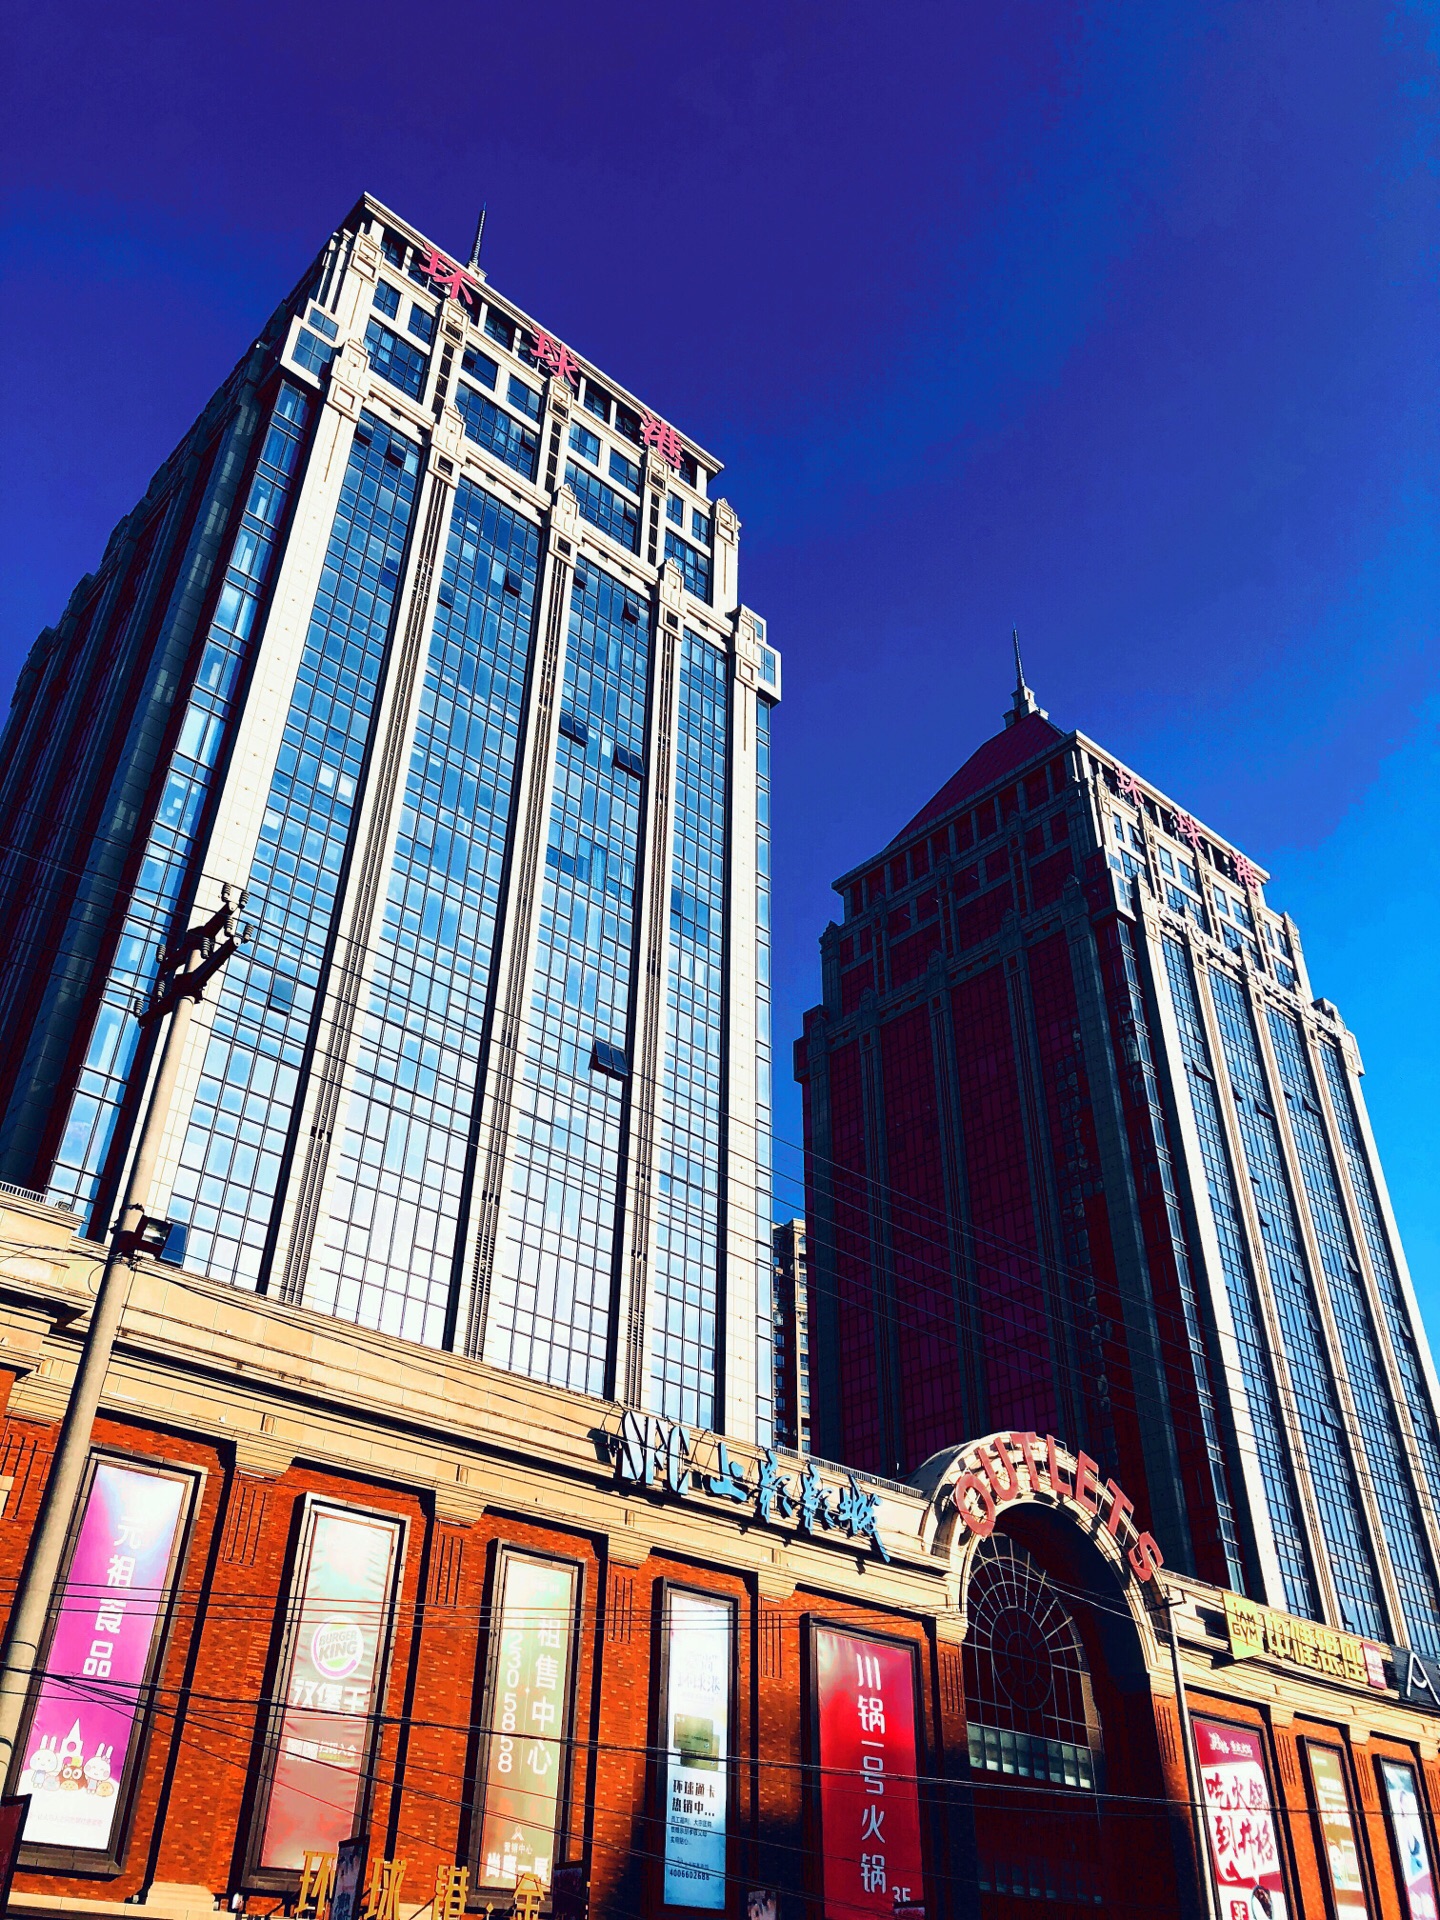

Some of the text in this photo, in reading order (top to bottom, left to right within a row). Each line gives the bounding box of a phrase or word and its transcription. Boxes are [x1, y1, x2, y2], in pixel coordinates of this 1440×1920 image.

[955, 1431, 1164, 1582] OUTLETS
[82, 1515, 143, 1678] 元祖食品
[318, 1629, 358, 1646] BURGER
[318, 1640, 359, 1660] KING
[1231, 1621, 1260, 1646] GYM
[291, 1679, 371, 1713] 汉堡王
[526, 1614, 562, 1776] 租售中心
[673, 1779, 715, 1798] 环球通卡
[856, 1653, 886, 1894] 川锅一号火锅
